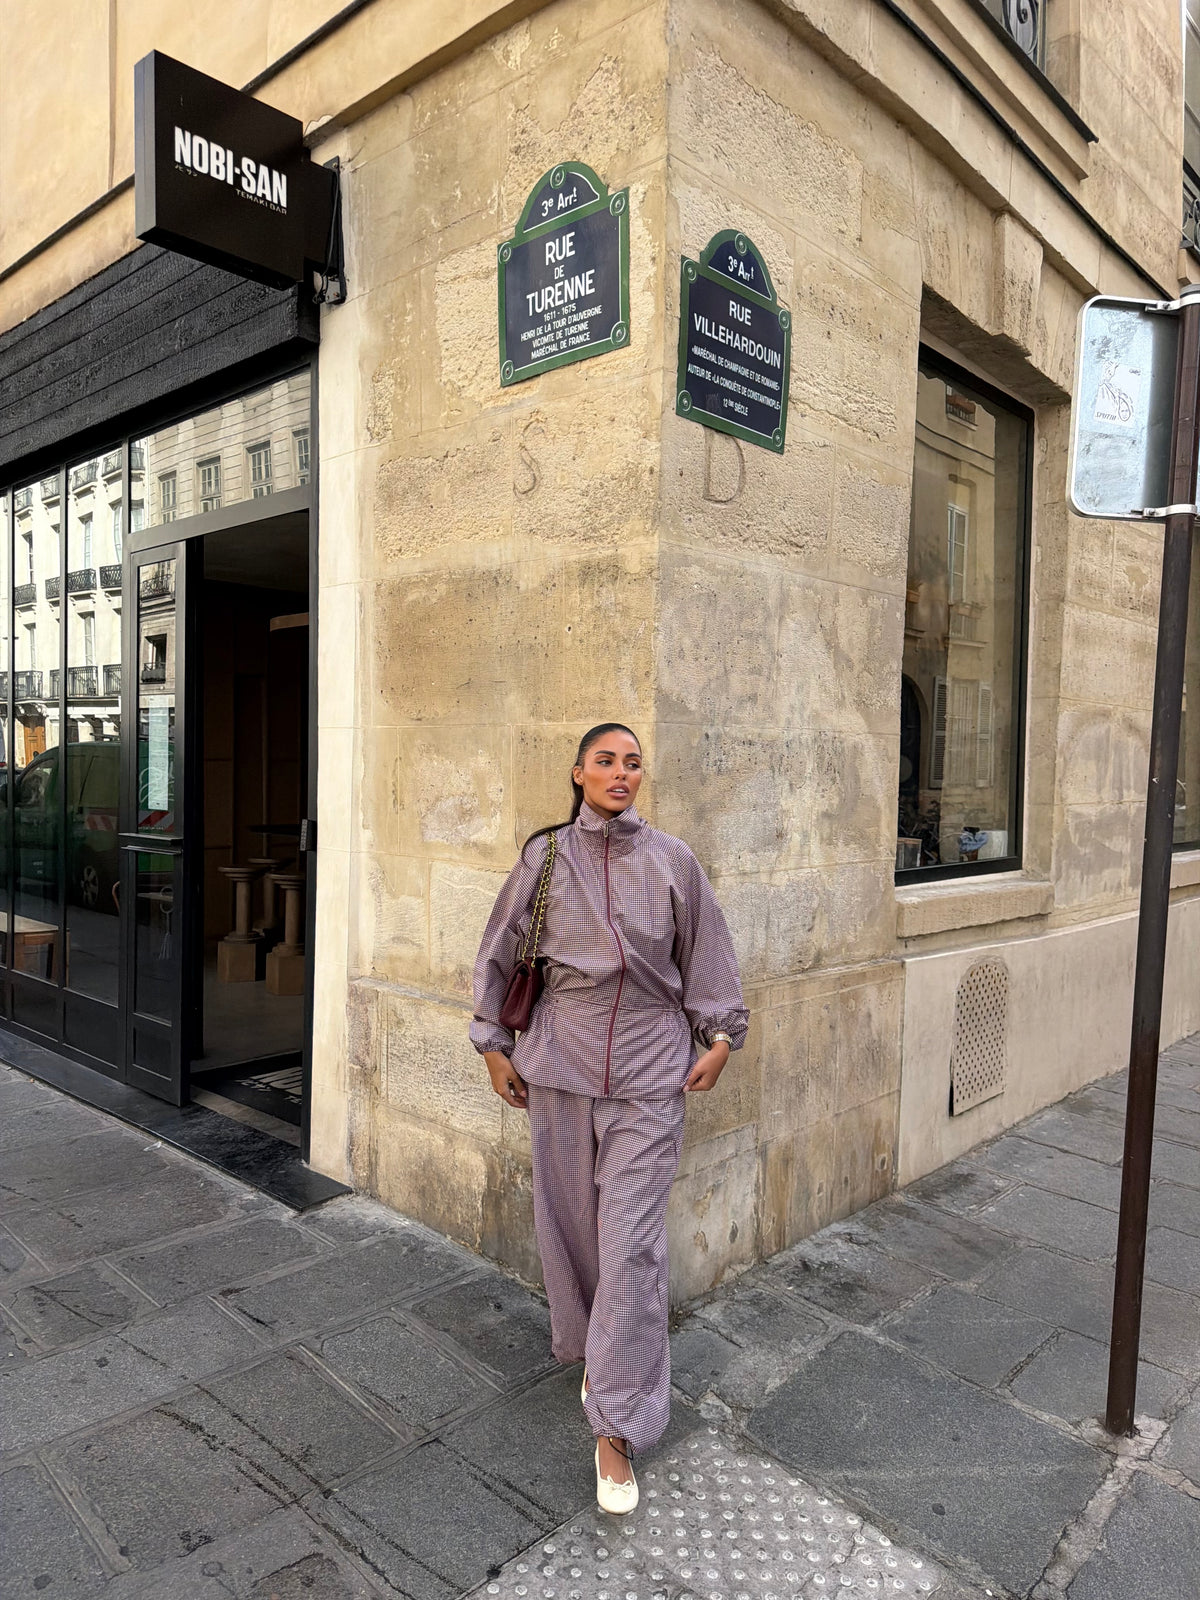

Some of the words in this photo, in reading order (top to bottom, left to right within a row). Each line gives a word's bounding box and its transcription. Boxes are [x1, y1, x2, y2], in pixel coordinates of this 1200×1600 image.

[174, 125, 287, 209] NOBI-SAN
[236, 188, 268, 207] TEMAKI
[541, 197, 554, 217] 3e
[545, 231, 575, 266] RUE
[554, 264, 565, 280] DE
[727, 255, 738, 273] 3e
[526, 268, 596, 317] TURENNE
[520, 328, 536, 342] HENRI
[536, 325, 544, 337] DE
[544, 323, 552, 333] LA
[552, 317, 567, 330] TOUR
[567, 304, 603, 324] D'AUVERGNE
[543, 310, 557, 323] 1611
[561, 302, 577, 316] 1675
[729, 300, 752, 326] RUE
[531, 342, 559, 360] MARÉCHAL
[559, 339, 568, 350] DE
[568, 331, 591, 347] FRANCE
[532, 332, 555, 349] VICOMTE
[555, 329, 563, 340] DE
[564, 320, 589, 337] TURENNE
[693, 313, 781, 369] VILLEHARDOUIN
[687, 362, 706, 379] AUTEUR
[705, 370, 712, 381] DE
[741, 385, 748, 397] DE
[717, 355, 725, 367] DE
[749, 370, 756, 381] ET
[755, 372, 761, 384] DE
